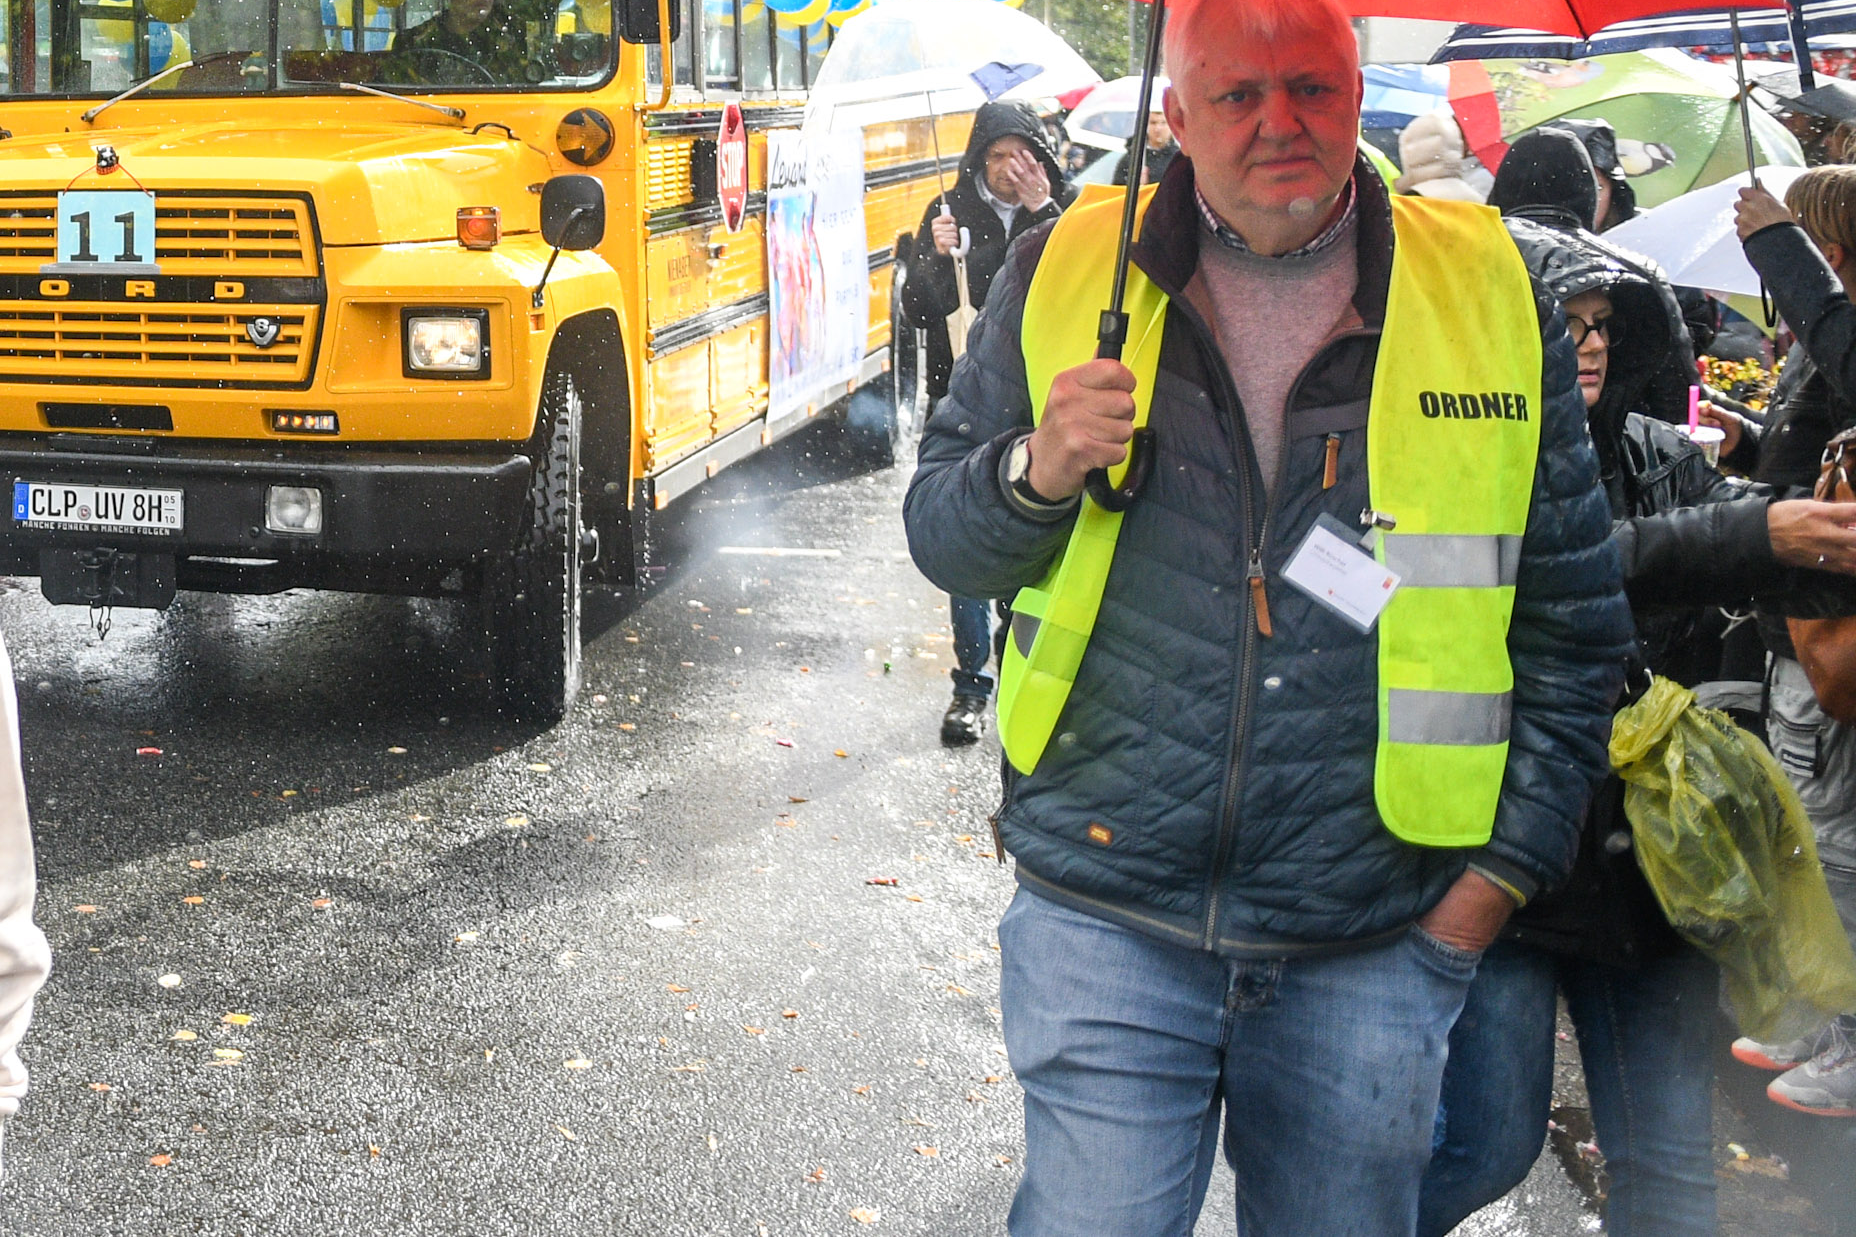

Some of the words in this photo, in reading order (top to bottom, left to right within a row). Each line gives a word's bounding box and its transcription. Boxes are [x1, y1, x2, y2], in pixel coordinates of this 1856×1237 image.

[721, 140, 745, 190] STOP
[70, 211, 143, 262] 11
[1419, 390, 1529, 422] ORDNER
[17, 504, 25, 514] D
[32, 488, 78, 518] CLP
[94, 491, 126, 521] UV
[132, 493, 163, 523] 8H
[163, 495, 176, 505] 05
[22, 520, 55, 530] MANCHE
[101, 525, 134, 534] MANCHE
[137, 527, 170, 536] FOLGEN
[164, 515, 176, 525] 10
